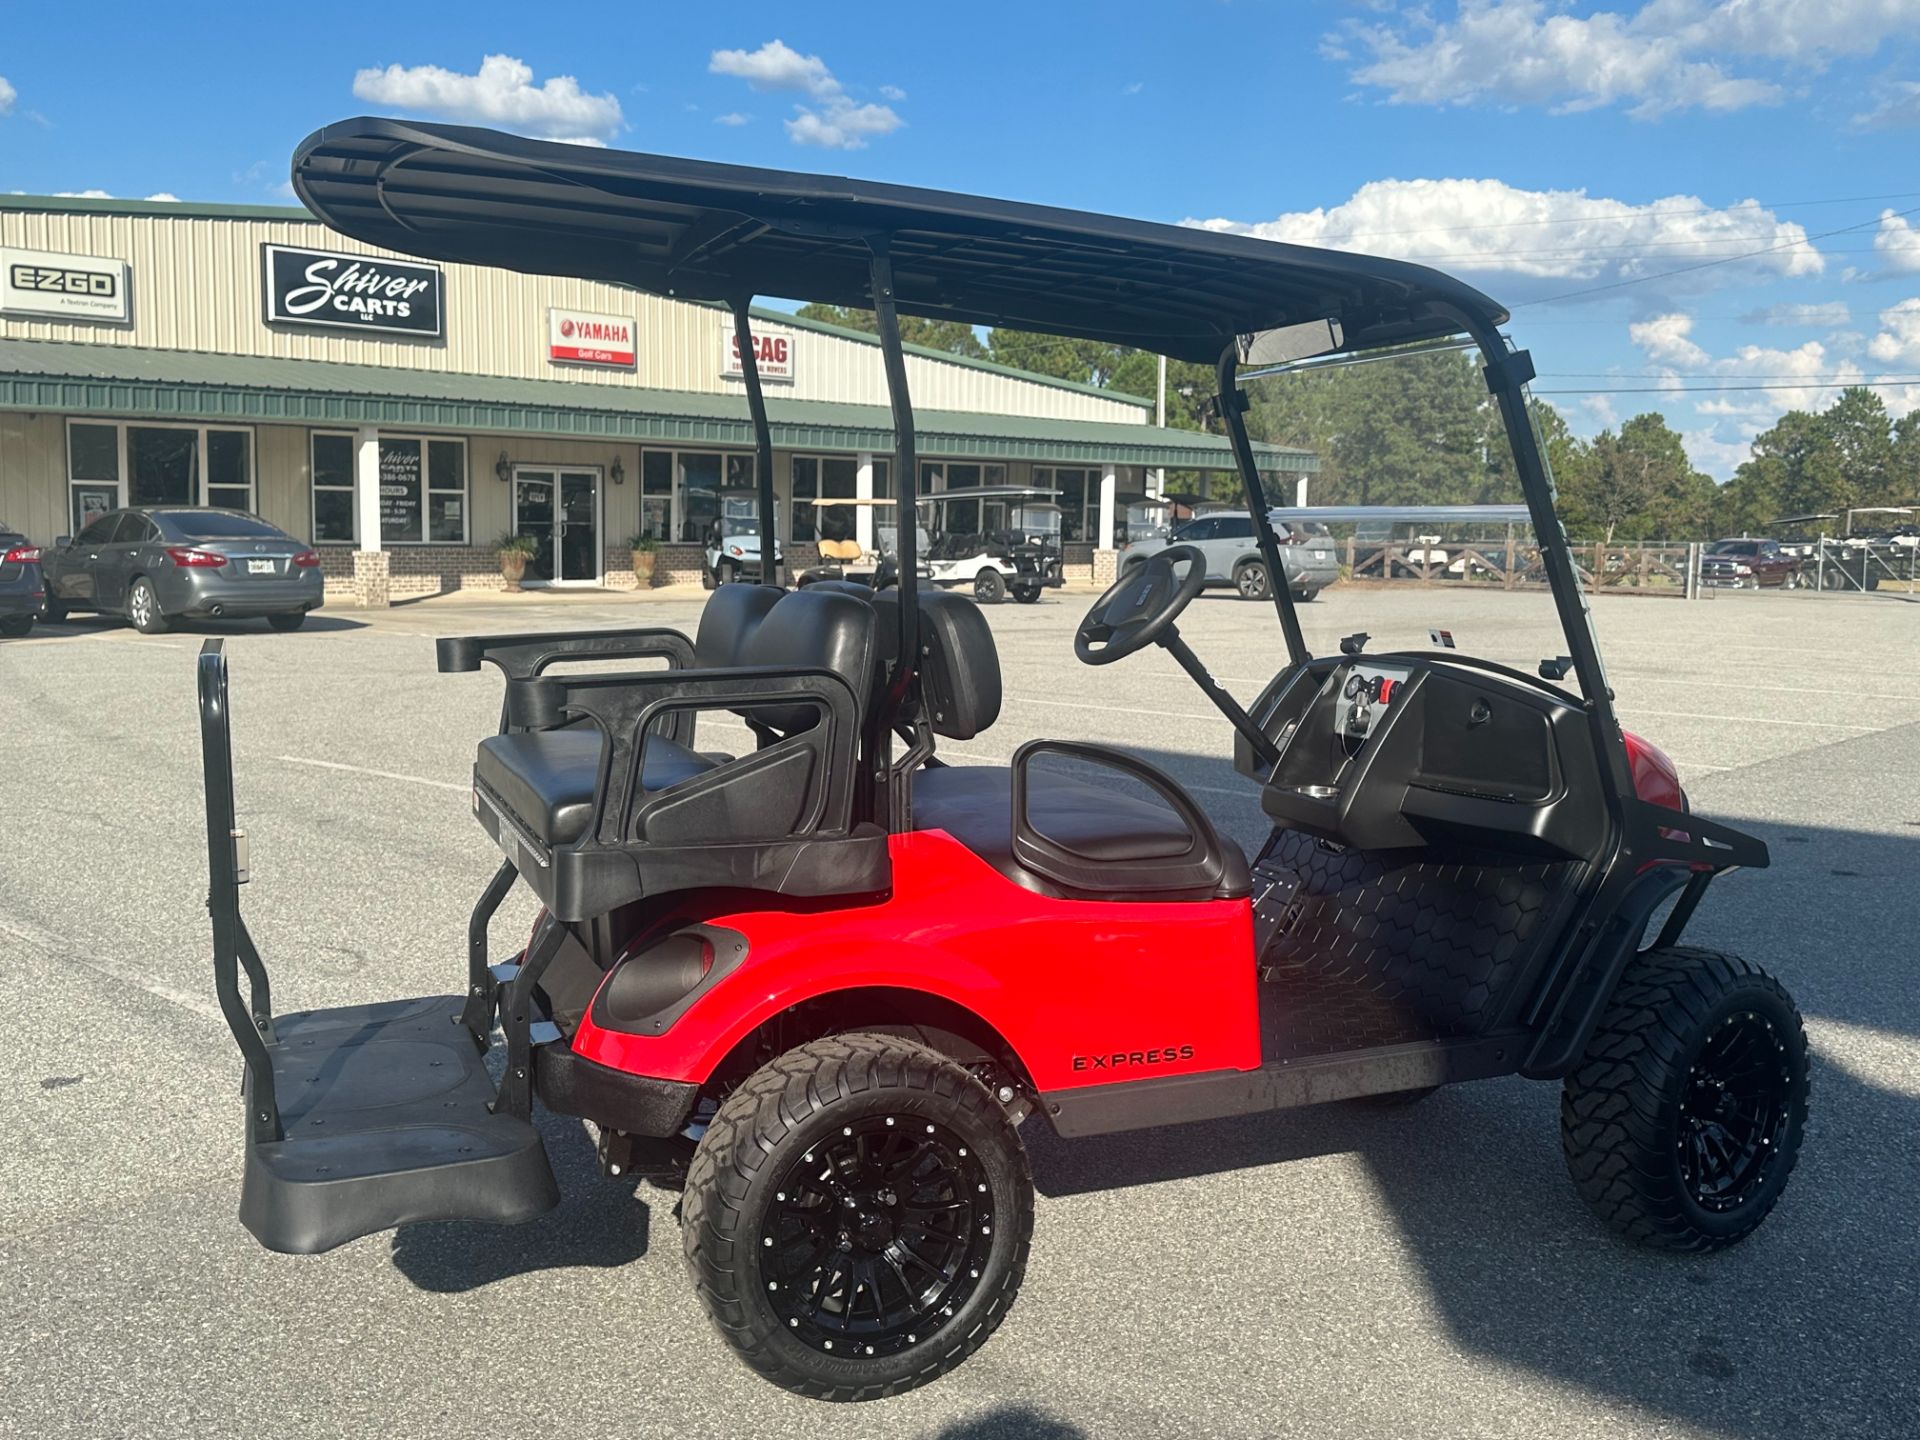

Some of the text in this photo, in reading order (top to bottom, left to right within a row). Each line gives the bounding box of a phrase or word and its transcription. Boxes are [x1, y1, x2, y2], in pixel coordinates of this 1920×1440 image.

[285, 259, 429, 314] Shiver
[90, 301, 117, 310] Company
[333, 295, 411, 317] CARTS
[360, 313, 374, 321] LLC
[576, 321, 629, 343] YAMAHA
[578, 349, 612, 360] Golf Cars
[380, 447, 420, 464] hiver
[1073, 1045, 1194, 1071] EXPRESS
